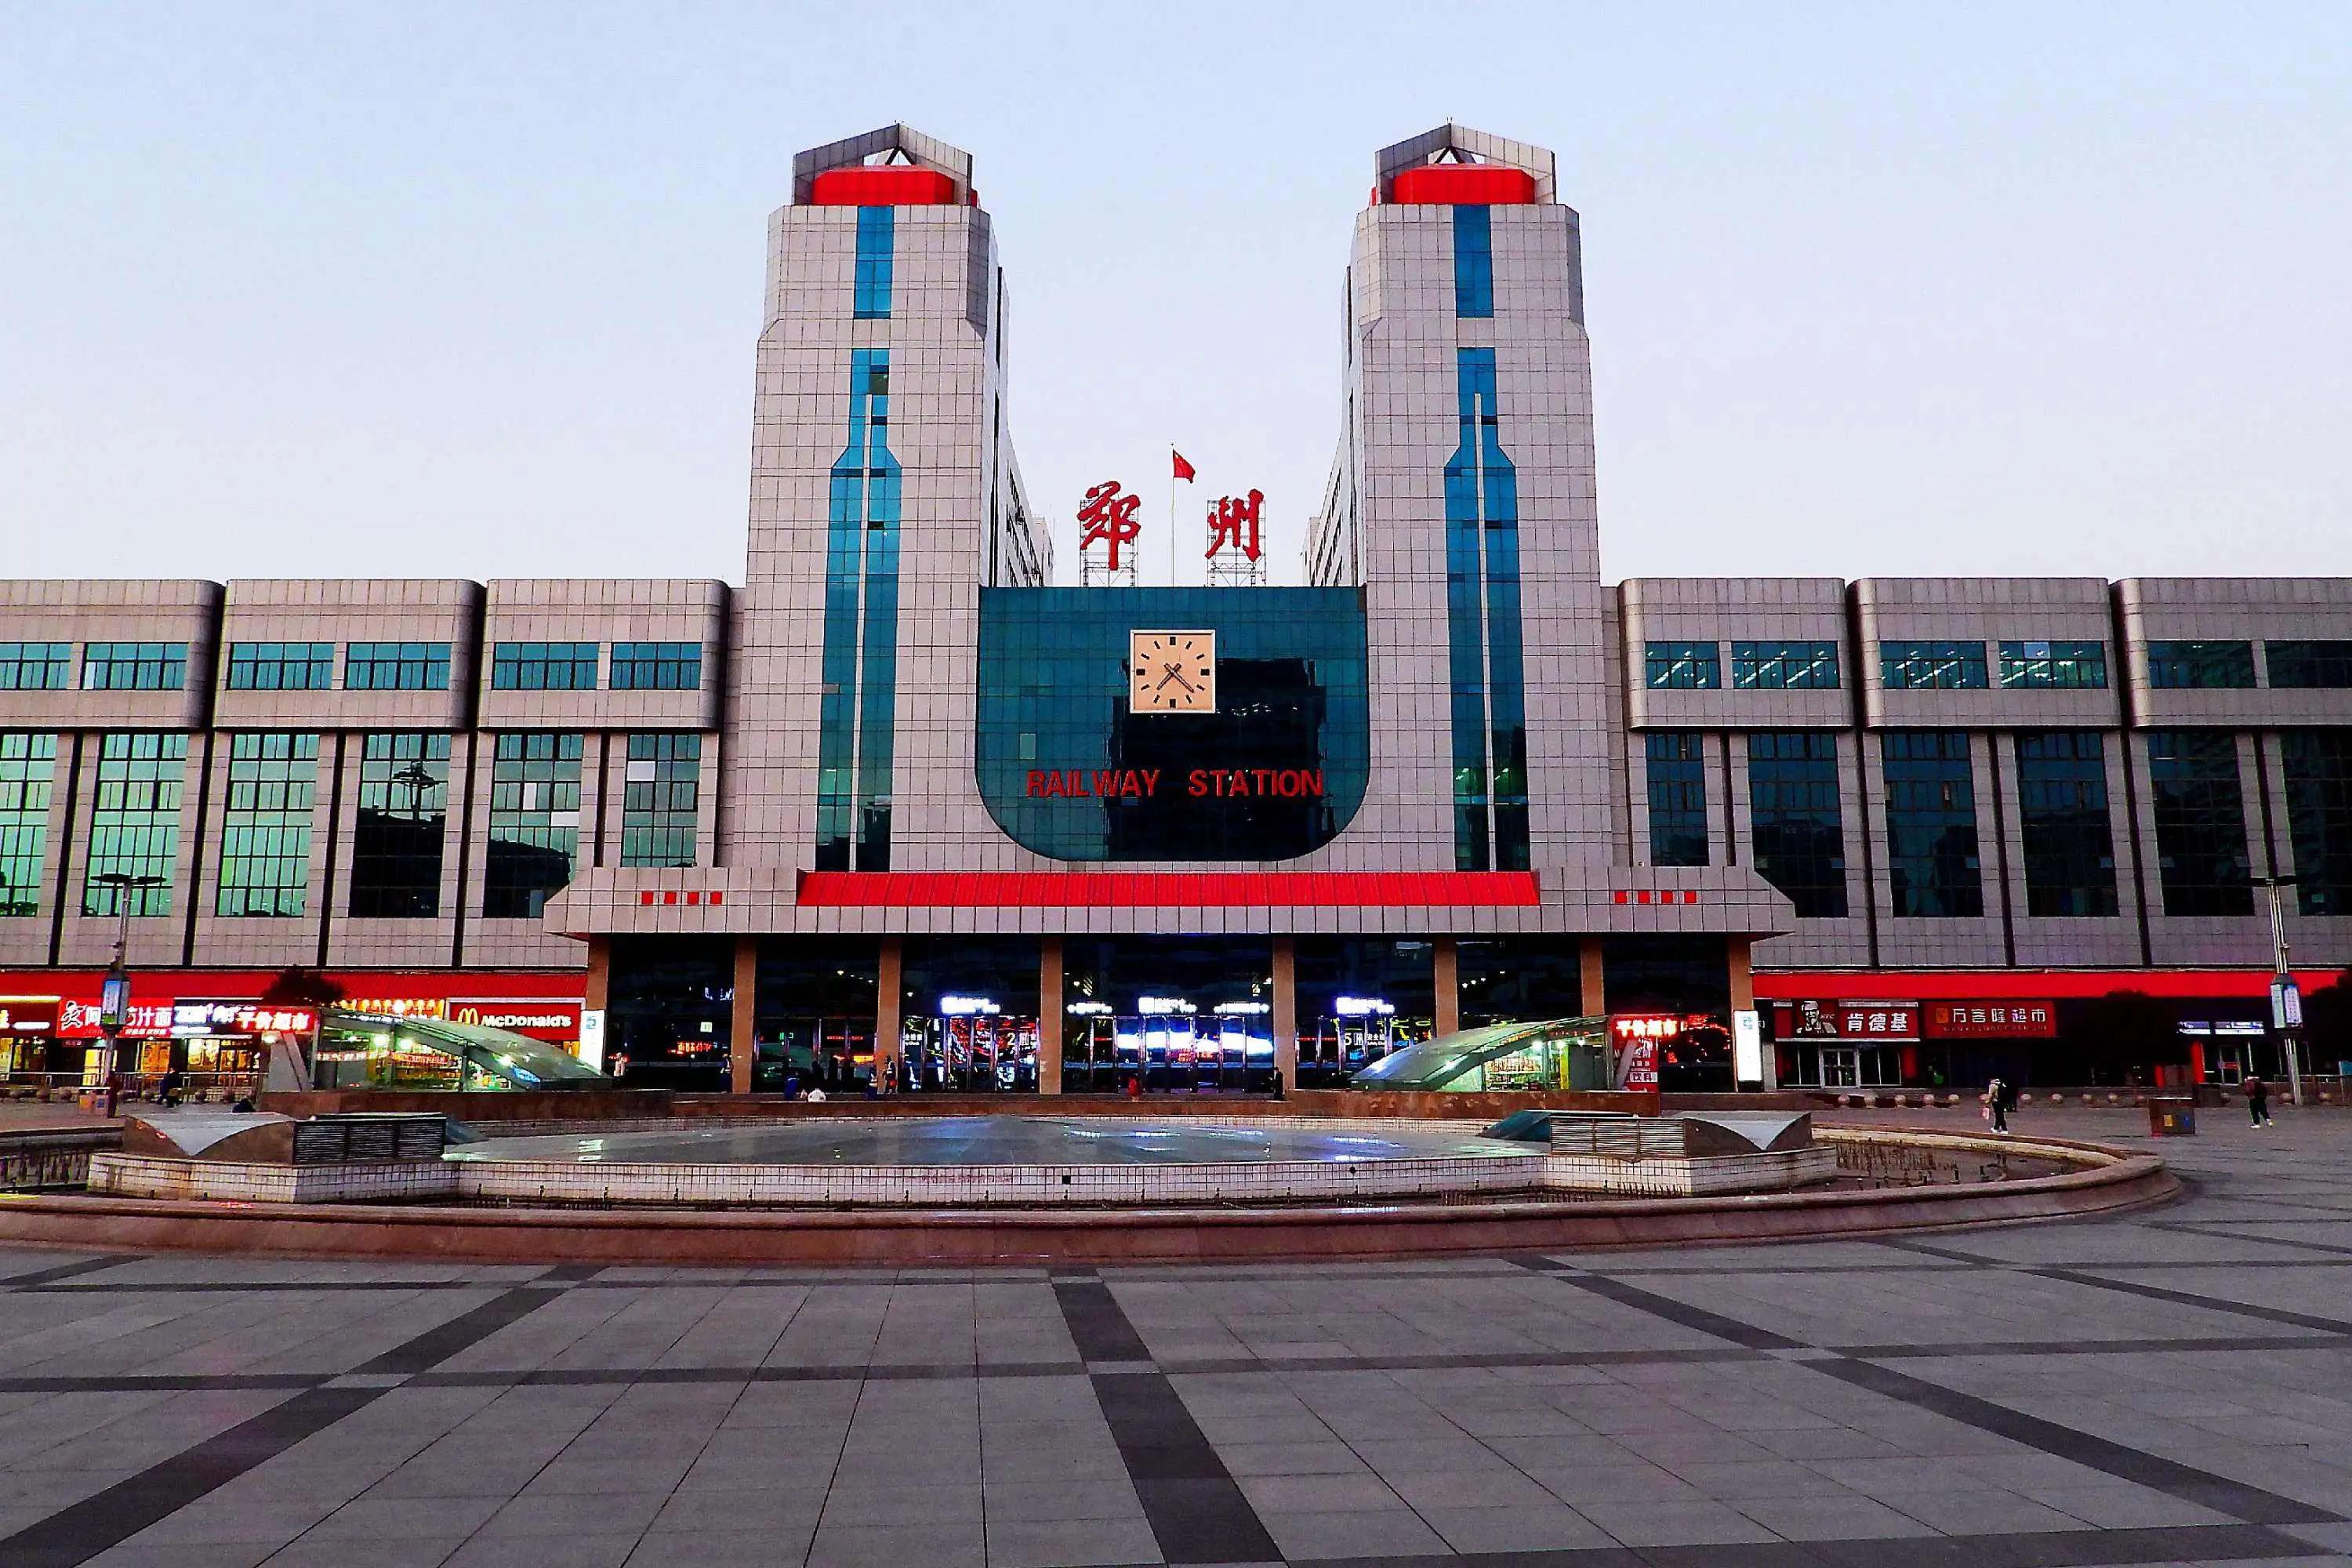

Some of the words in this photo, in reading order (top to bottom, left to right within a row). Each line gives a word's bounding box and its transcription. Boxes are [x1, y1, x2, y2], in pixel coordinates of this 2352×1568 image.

[1077, 481, 1264, 570] 郑州
[1026, 769, 1160, 797] RAILWAY
[1189, 769, 1323, 797] STATION
[85, 1006, 172, 1026] 阿汁面
[481, 1014, 572, 1027] McDonald's
[1847, 1012, 1908, 1032] 肯德基
[1952, 1008, 2046, 1023] 万客隆超市
